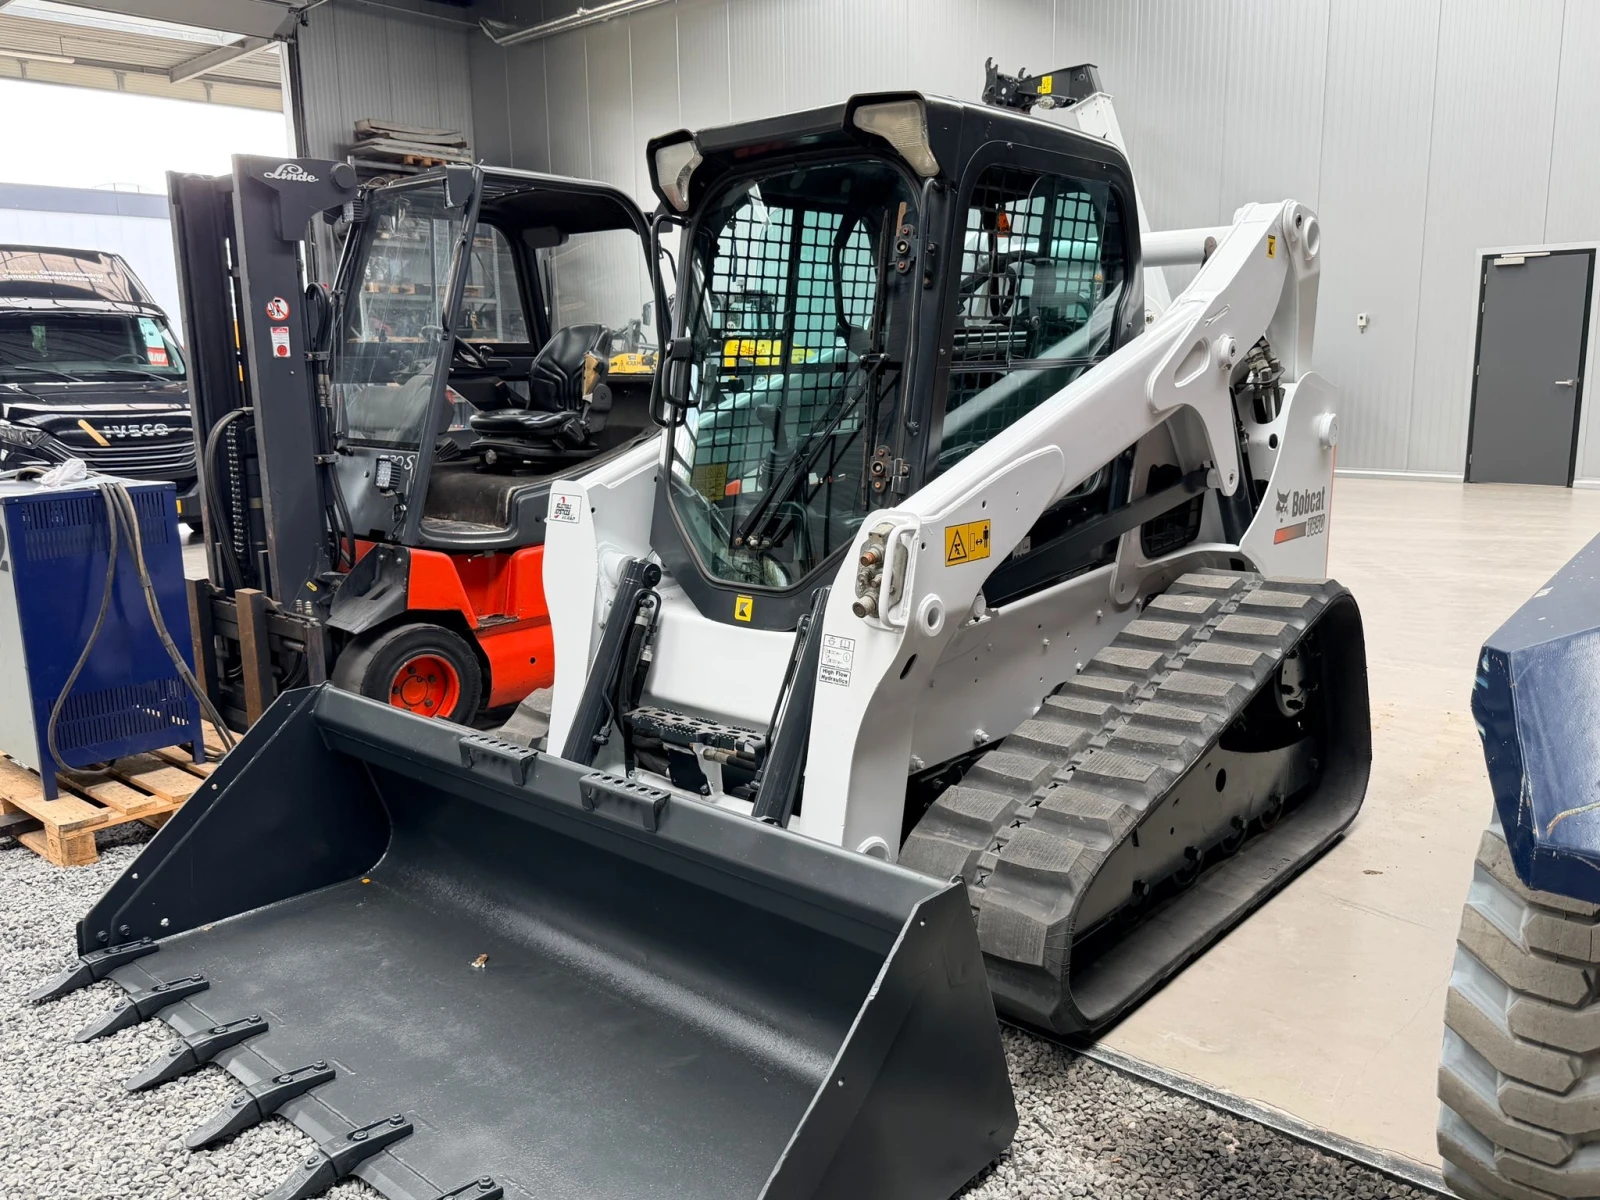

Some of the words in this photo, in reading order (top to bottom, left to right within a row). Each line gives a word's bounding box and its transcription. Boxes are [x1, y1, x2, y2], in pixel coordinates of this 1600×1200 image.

[263, 163, 320, 183] Linde
[103, 423, 169, 438] IVECO
[1292, 486, 1325, 517] Bobcat
[821, 674, 848, 684] Hydraulics
